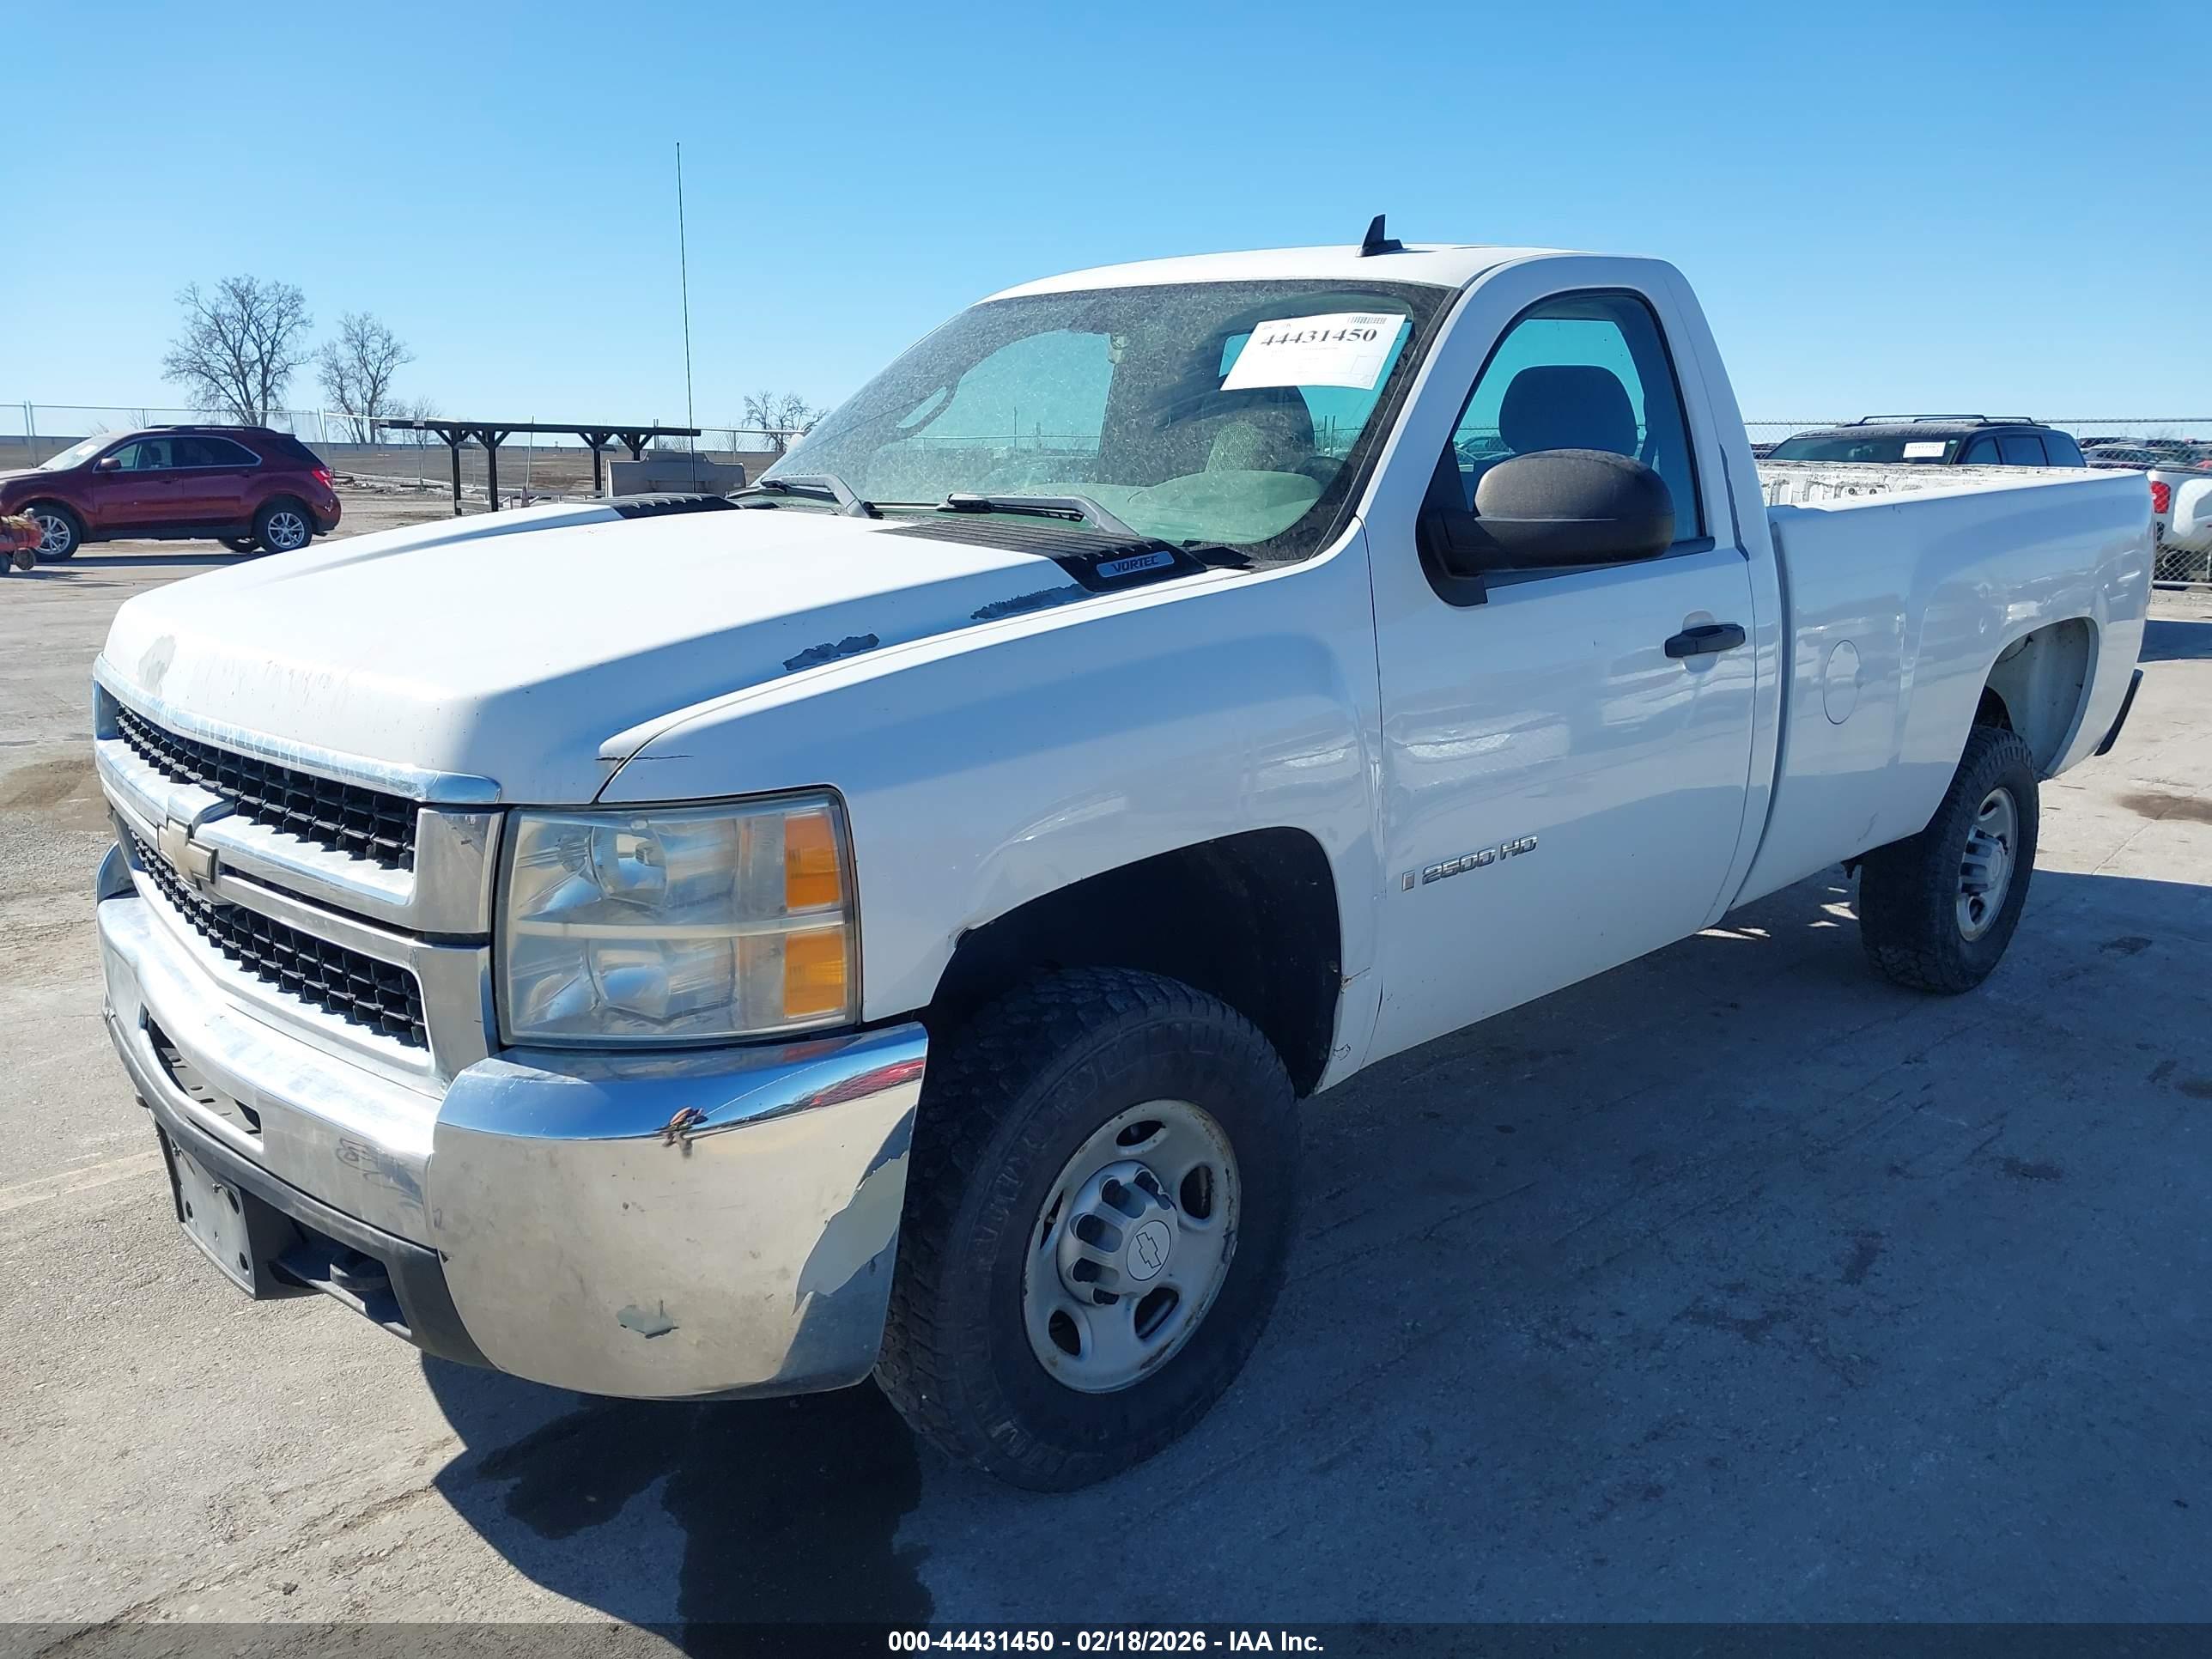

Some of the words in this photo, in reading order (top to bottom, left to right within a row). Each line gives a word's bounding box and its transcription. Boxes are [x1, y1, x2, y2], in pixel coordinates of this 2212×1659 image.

[1261, 328, 1377, 346] 44431450
[1111, 556, 1159, 573] VORTEC
[1422, 847, 1496, 885] 2500
[1500, 834, 1538, 860] HD
